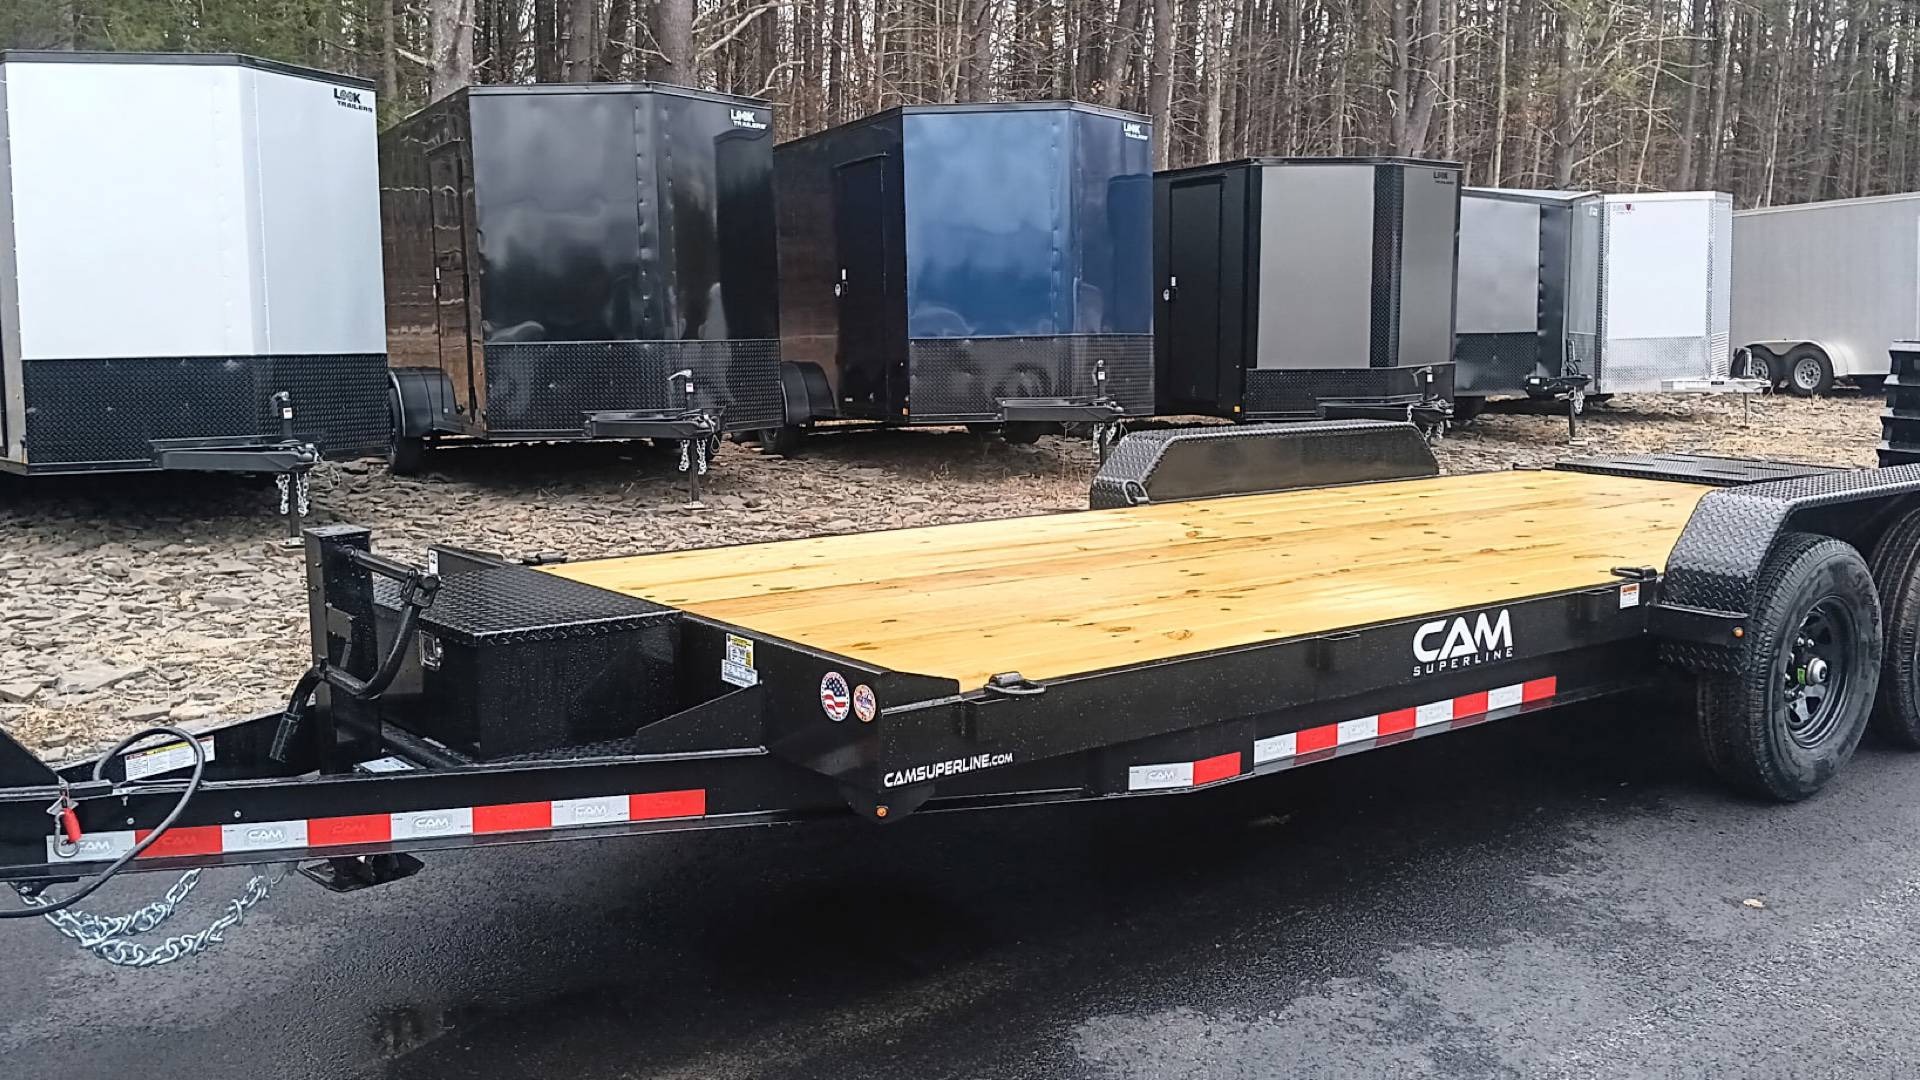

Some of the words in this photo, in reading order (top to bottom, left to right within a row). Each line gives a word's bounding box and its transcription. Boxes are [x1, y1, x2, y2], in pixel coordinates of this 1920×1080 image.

[334, 88, 360, 104] LOOK
[337, 100, 372, 112] TRAILERS
[1413, 609, 1513, 663] CAM
[1413, 647, 1513, 676] SUPERLINE
[576, 805, 607, 817] CAM
[414, 817, 450, 829] CAM
[247, 828, 283, 841] CAM
